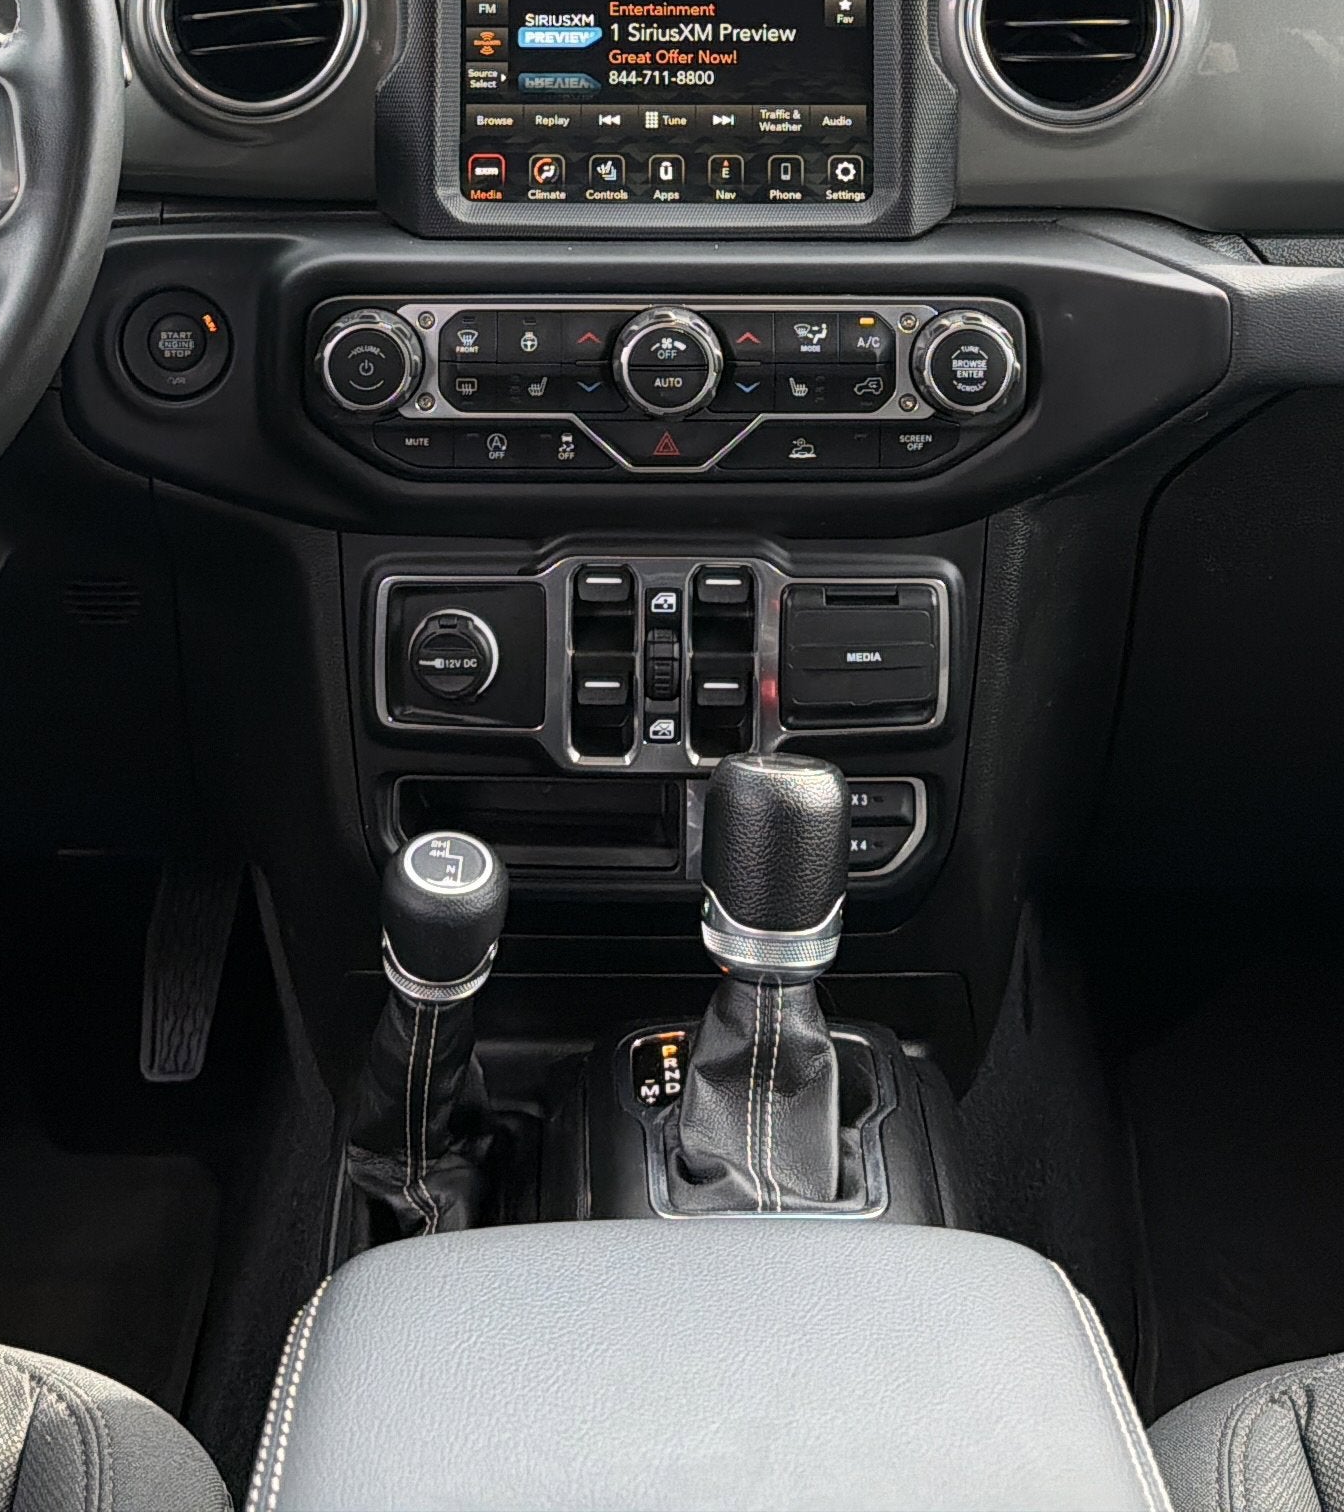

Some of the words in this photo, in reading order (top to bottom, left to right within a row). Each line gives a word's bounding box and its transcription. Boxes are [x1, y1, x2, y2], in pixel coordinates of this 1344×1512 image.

[478, 3, 497, 14] FM
[609, 1, 716, 17] Entertainment
[525, 13, 595, 27] SIRIUSXM
[836, 14, 854, 24] Fav
[524, 31, 595, 44] PREVIEW
[611, 24, 619, 41] 1
[628, 24, 713, 42] SiriusXM
[719, 23, 797, 42] Preview
[609, 50, 652, 64] Great
[656, 50, 694, 64] Offer
[698, 50, 738, 64] Now!
[468, 69, 498, 78] Source
[609, 70, 715, 85] 844-711-8800
[470, 79, 497, 88] Select
[760, 109, 790, 120] Traffic
[792, 109, 801, 120] &
[476, 115, 513, 126] Browse
[535, 115, 570, 127] Replay
[662, 115, 687, 126] Tune
[822, 116, 853, 126] Audio
[759, 121, 802, 132] Weather
[470, 189, 502, 200] Media
[528, 190, 566, 200] Climate
[586, 190, 628, 200] Controls
[653, 190, 680, 201] Apps
[715, 190, 736, 200] Nav
[769, 190, 802, 200] Phone
[826, 190, 866, 201] Settings
[160, 331, 193, 340] START
[159, 341, 194, 349] ENGINE
[857, 337, 881, 348] A/C
[351, 346, 381, 356] VOLUME
[800, 345, 821, 353] MODE
[657, 350, 677, 360] OFF
[952, 359, 987, 368] BROWSE
[957, 370, 984, 379] ENTER
[654, 377, 683, 387] AUTO
[956, 383, 982, 393] SCROLL
[405, 438, 429, 446] MUTE
[899, 434, 932, 443] SCREEN
[907, 443, 924, 451] OFF
[489, 451, 505, 459] OFF
[558, 452, 575, 460] OFF
[846, 652, 881, 663] MEDIA
[444, 657, 460, 669] 12V
[463, 657, 478, 669] DC
[429, 849, 445, 858] 4H
[445, 864, 456, 874] N
[662, 1044, 678, 1057] P
[663, 1057, 678, 1069] R
[664, 1069, 681, 1081] N
[641, 1084, 659, 1097] M
[666, 1083, 681, 1094] D
